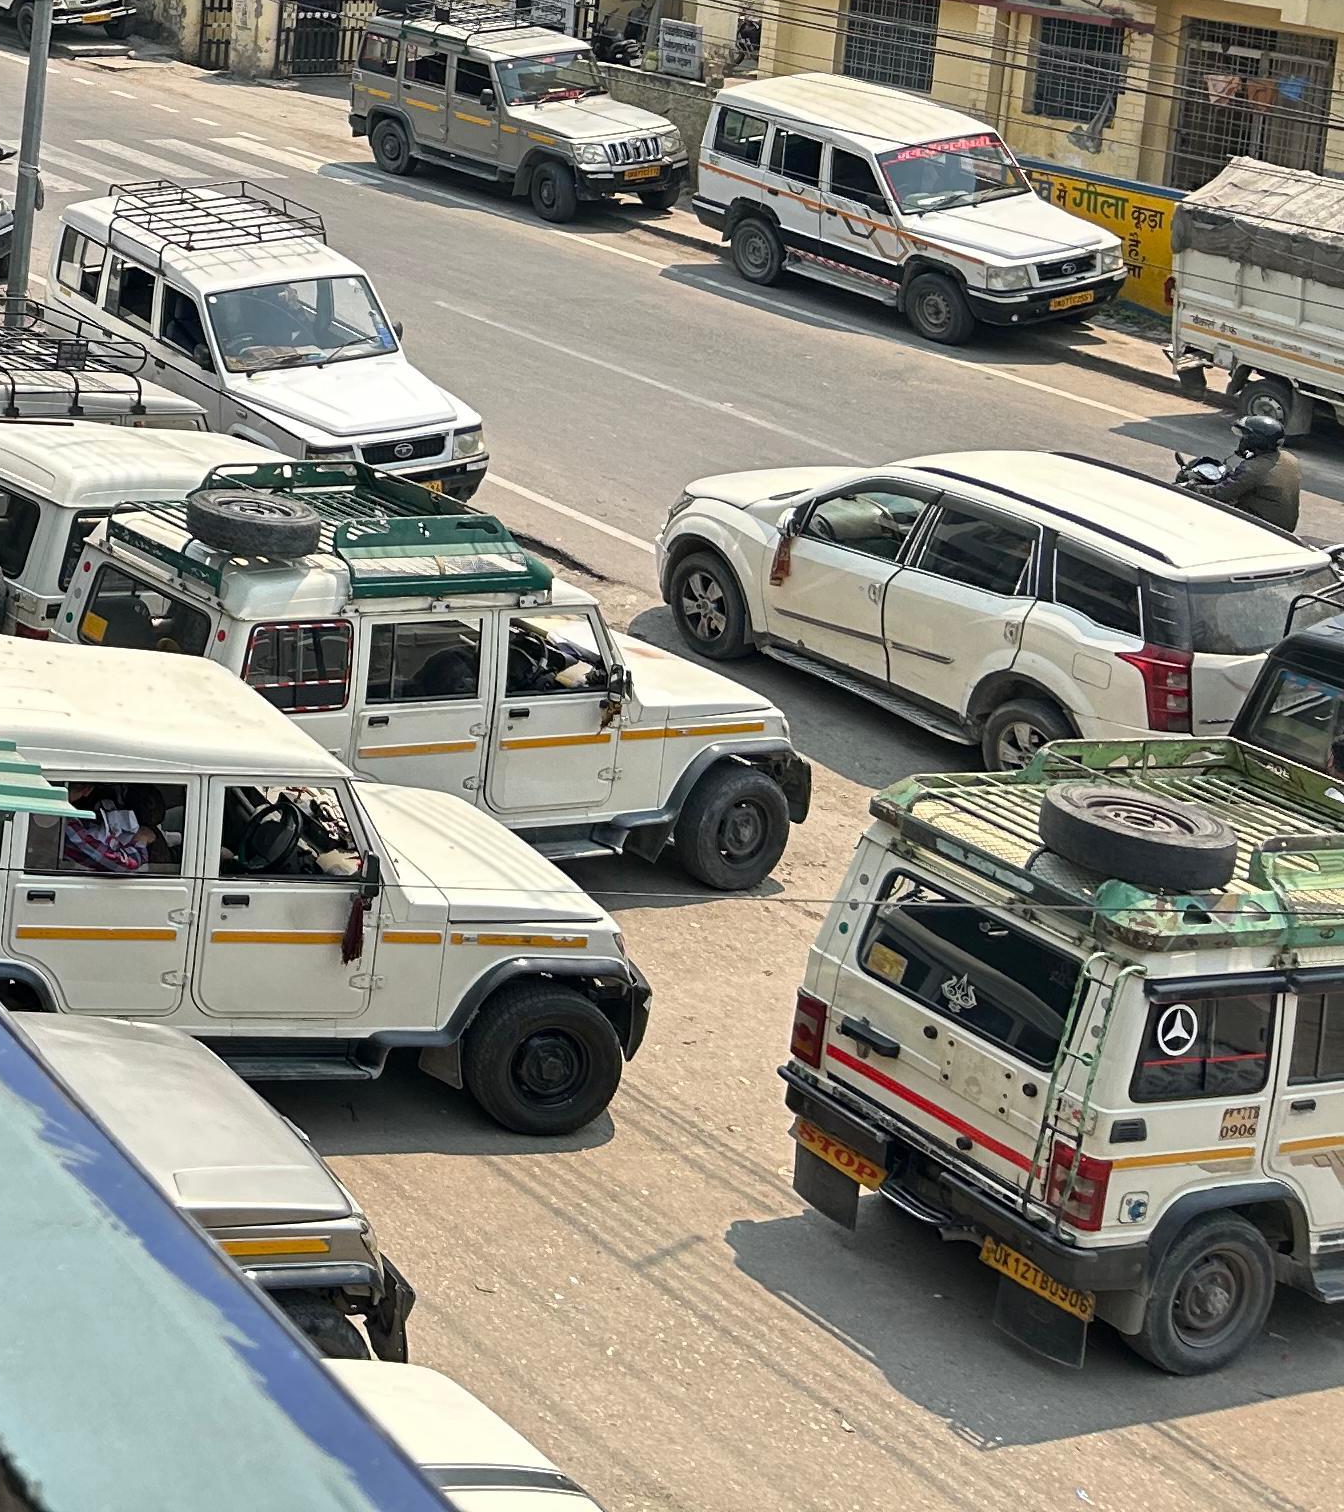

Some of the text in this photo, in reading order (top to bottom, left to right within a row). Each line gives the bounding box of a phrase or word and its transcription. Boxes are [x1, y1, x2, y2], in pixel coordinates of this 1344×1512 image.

[1071, 182, 1130, 221] गीला
[1131, 205, 1165, 232] कूड़ा
[797, 1119, 879, 1181] STOP
[1220, 1124, 1257, 1139] 0906
